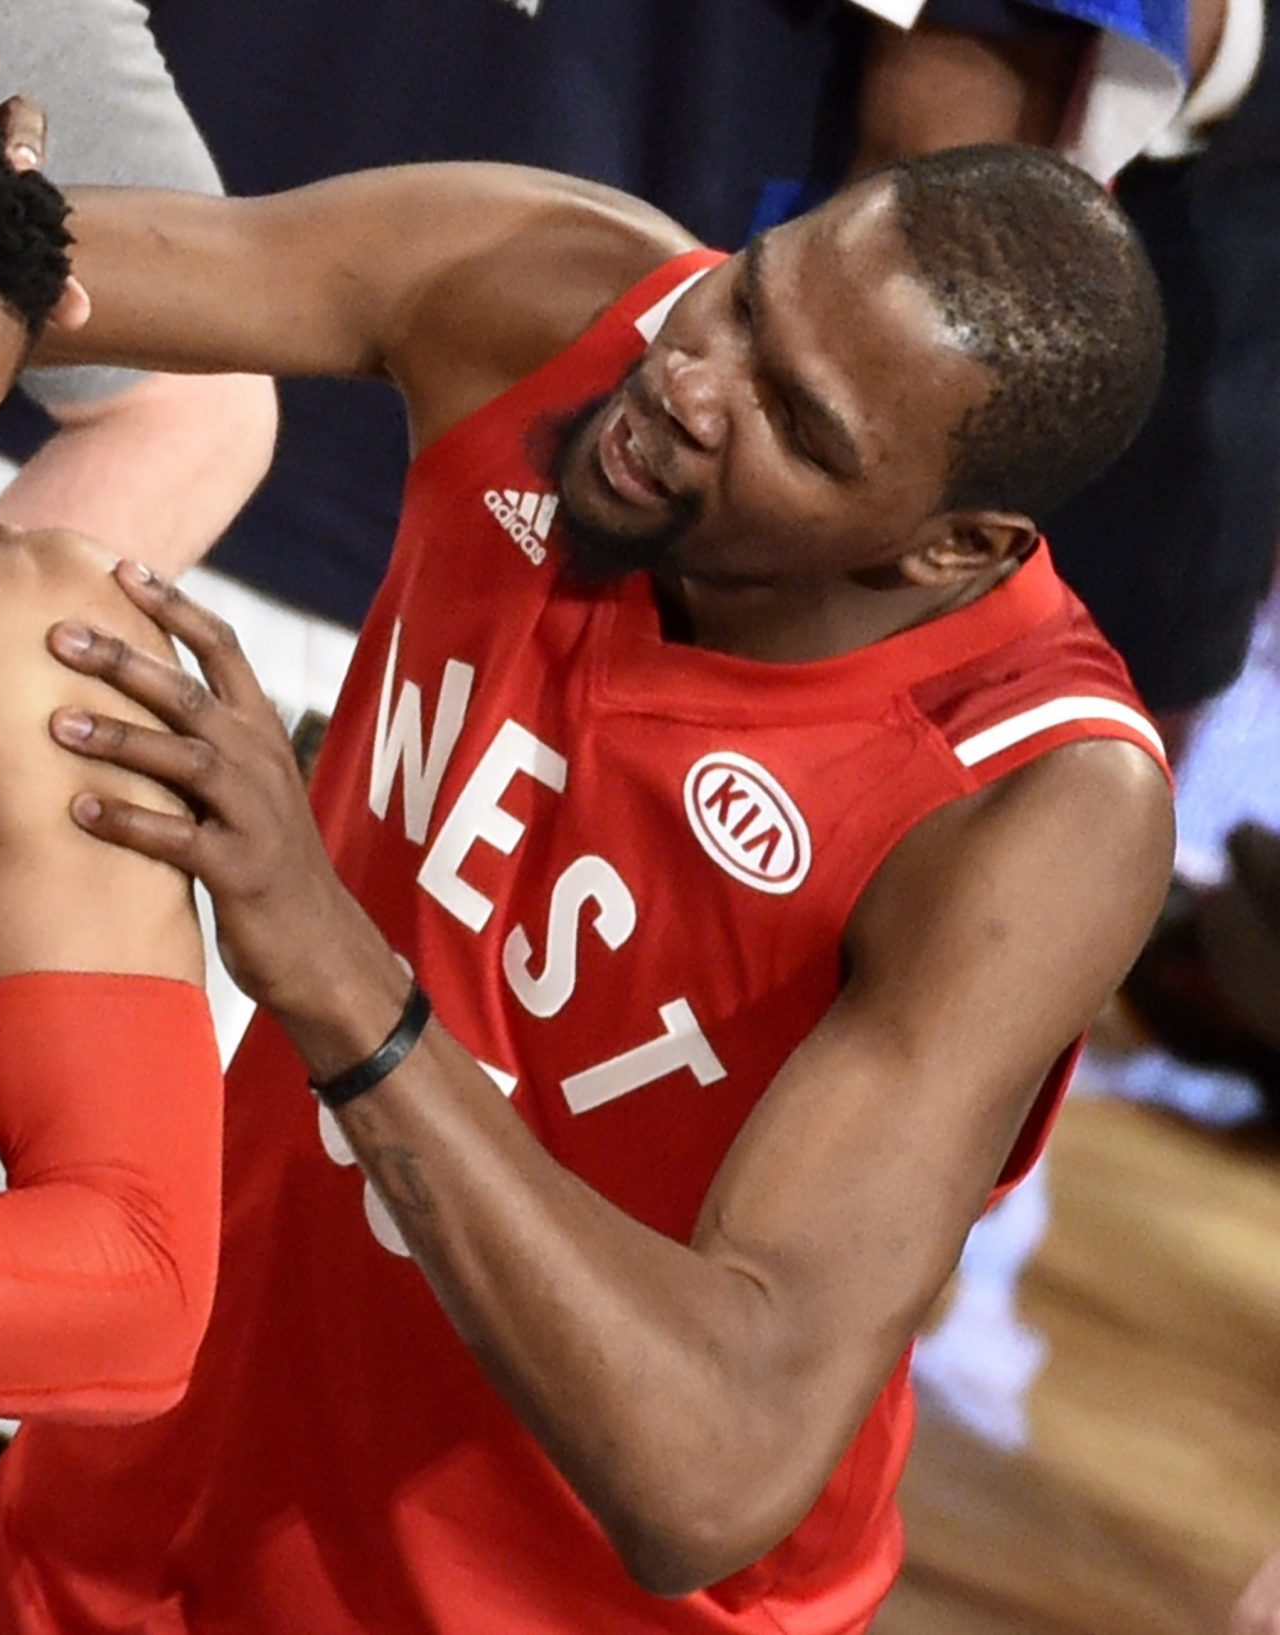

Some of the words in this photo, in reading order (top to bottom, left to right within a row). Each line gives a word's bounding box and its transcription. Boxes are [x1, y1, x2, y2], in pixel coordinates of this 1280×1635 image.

[483, 489, 547, 566] adidas
[368, 616, 727, 1116] WEST
[704, 774, 782, 872] KIA
